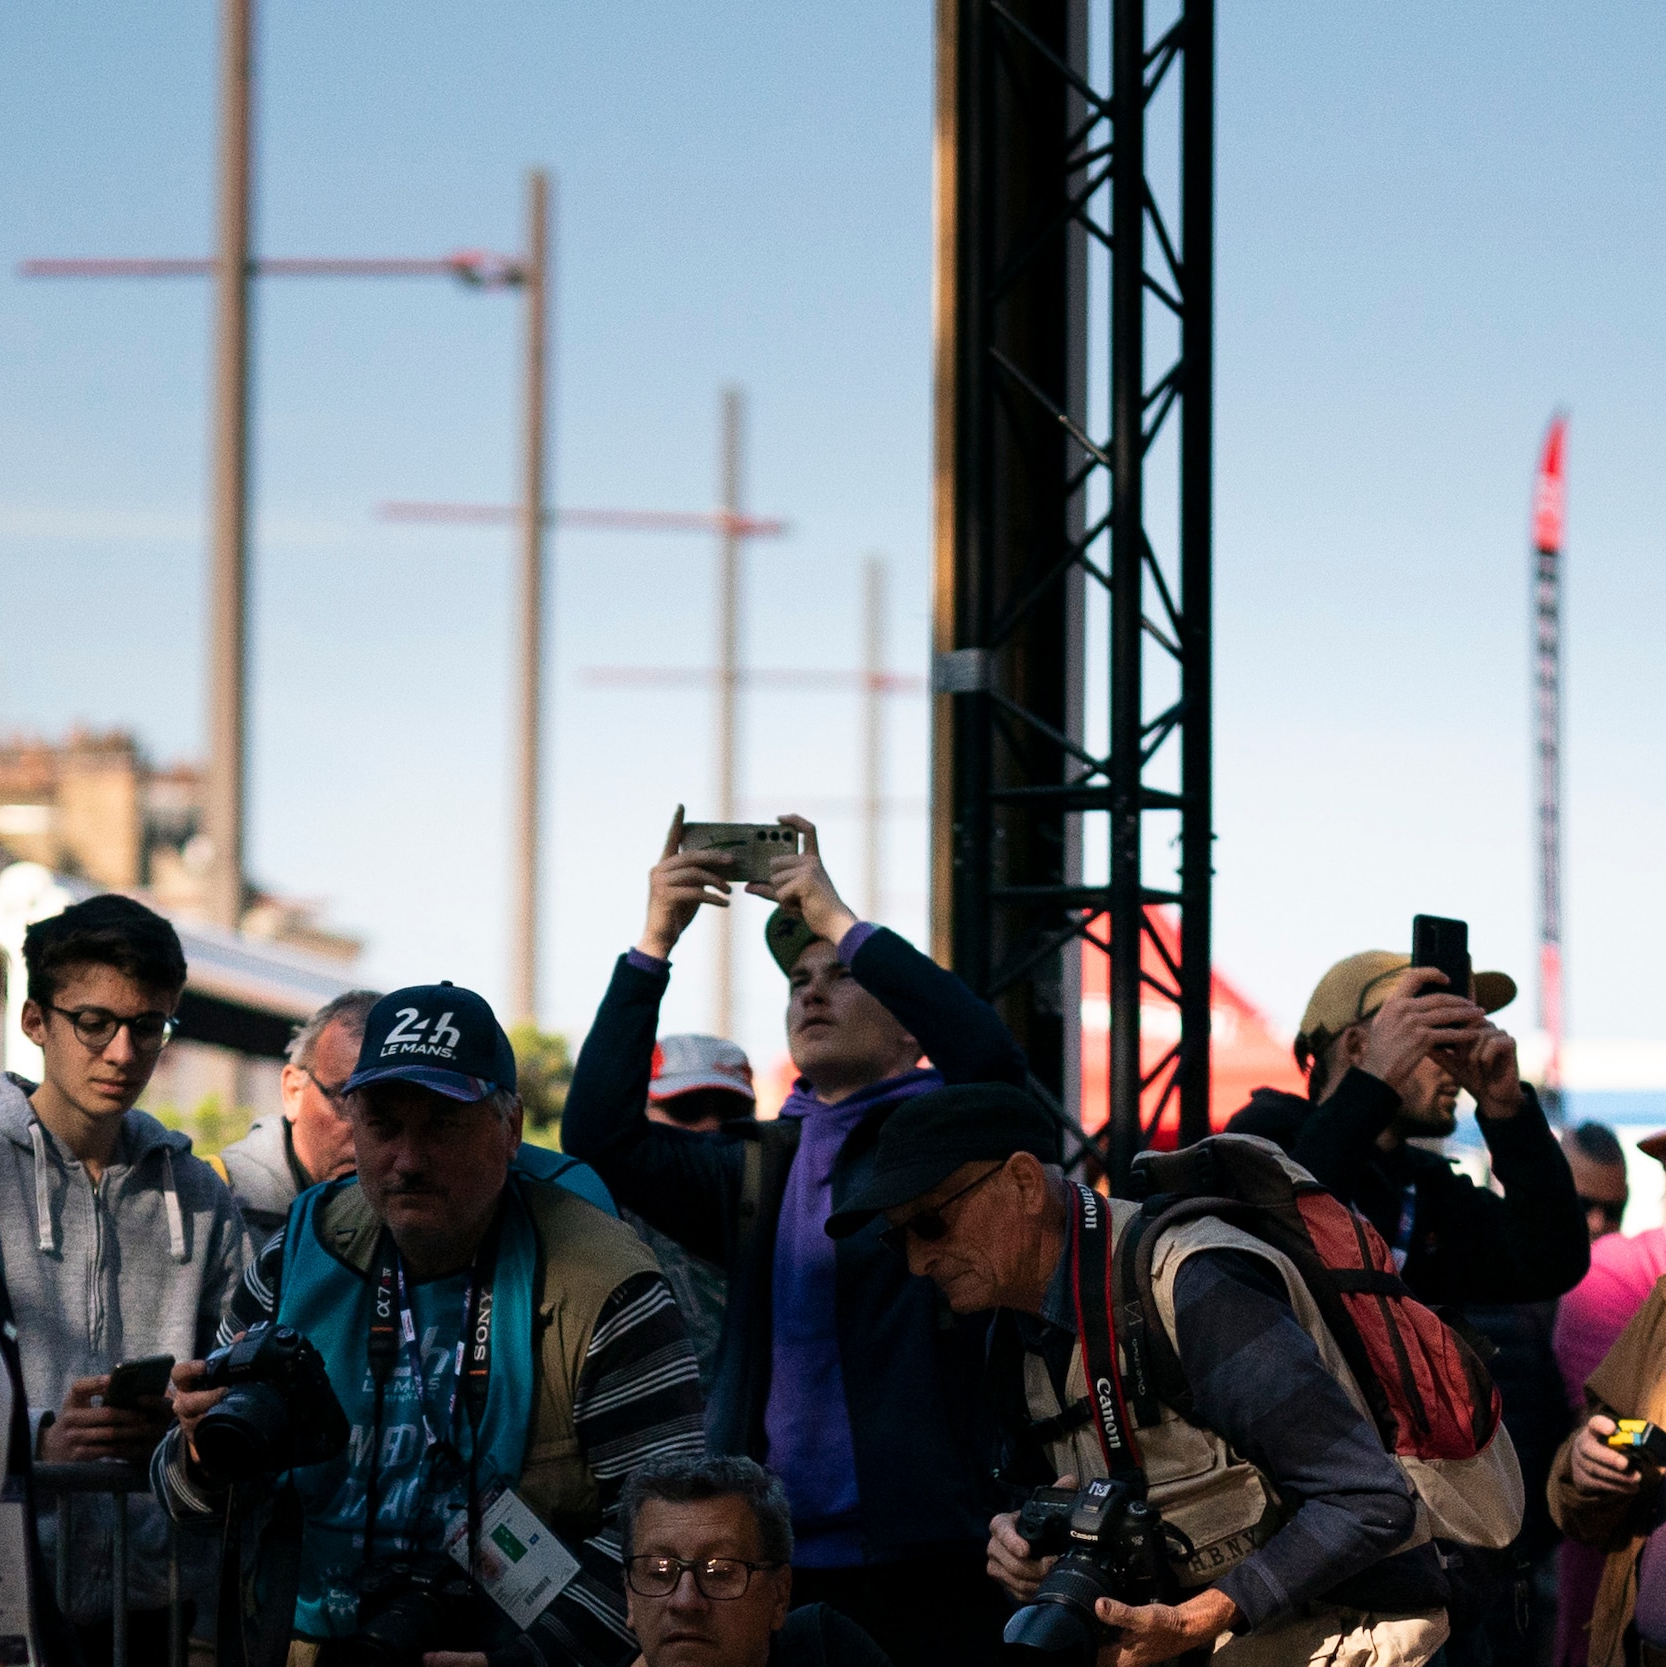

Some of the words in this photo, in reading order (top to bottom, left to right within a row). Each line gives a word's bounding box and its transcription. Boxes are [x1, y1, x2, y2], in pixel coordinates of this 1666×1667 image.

[384, 1007, 461, 1048] 24h
[380, 1043, 399, 1058] LE
[399, 1043, 453, 1059] MANS
[474, 1290, 493, 1361] SONY
[1096, 1377, 1121, 1449] Canon
[1069, 1529, 1100, 1541] Canon
